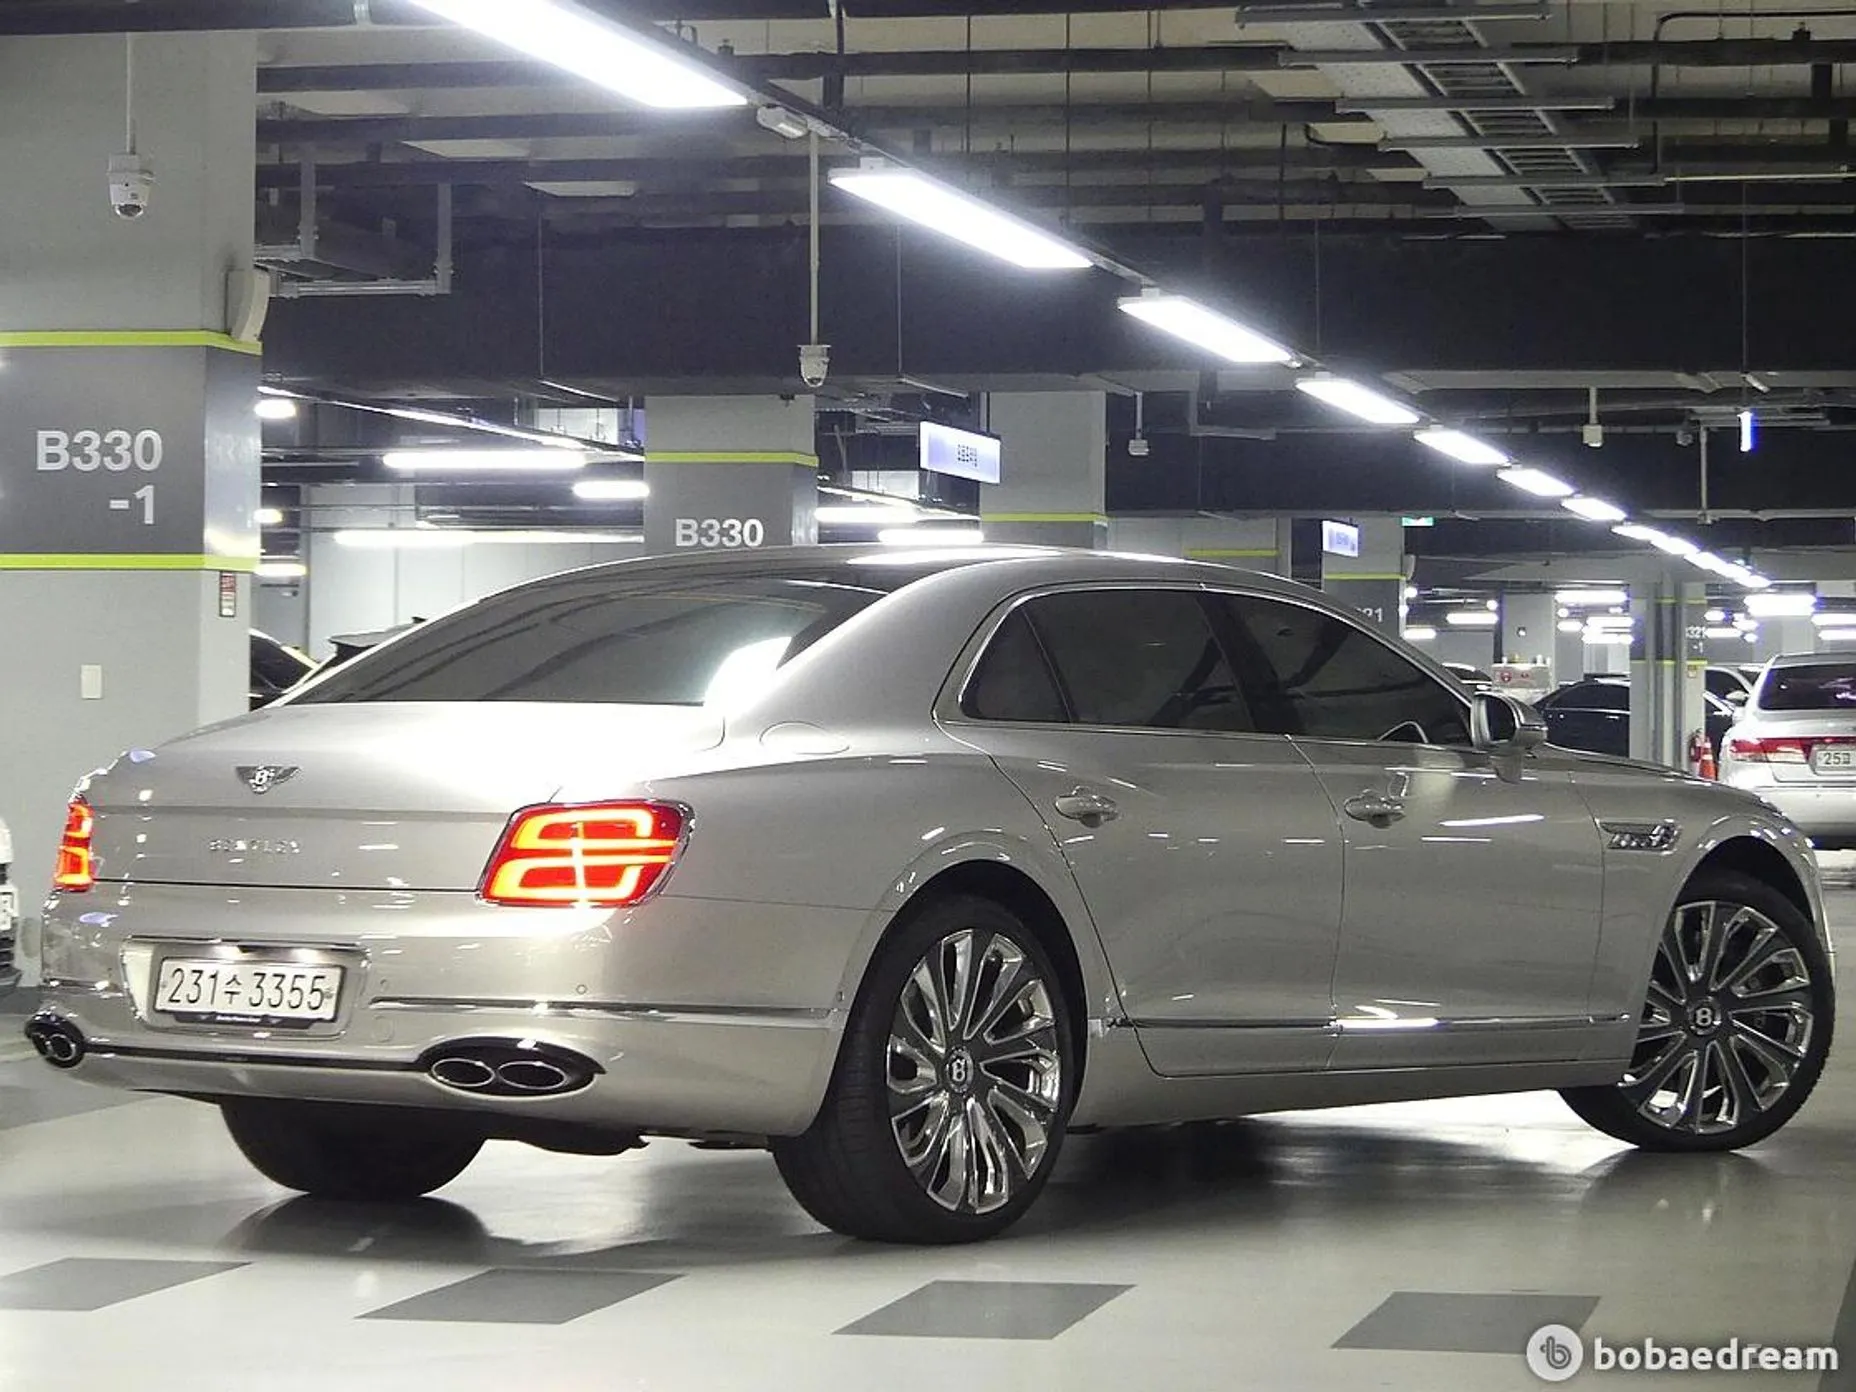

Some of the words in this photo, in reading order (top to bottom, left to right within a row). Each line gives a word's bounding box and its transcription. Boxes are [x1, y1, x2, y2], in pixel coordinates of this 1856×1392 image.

[36, 429, 163, 471] B330
[109, 484, 155, 525] -1
[675, 518, 764, 547] B330
